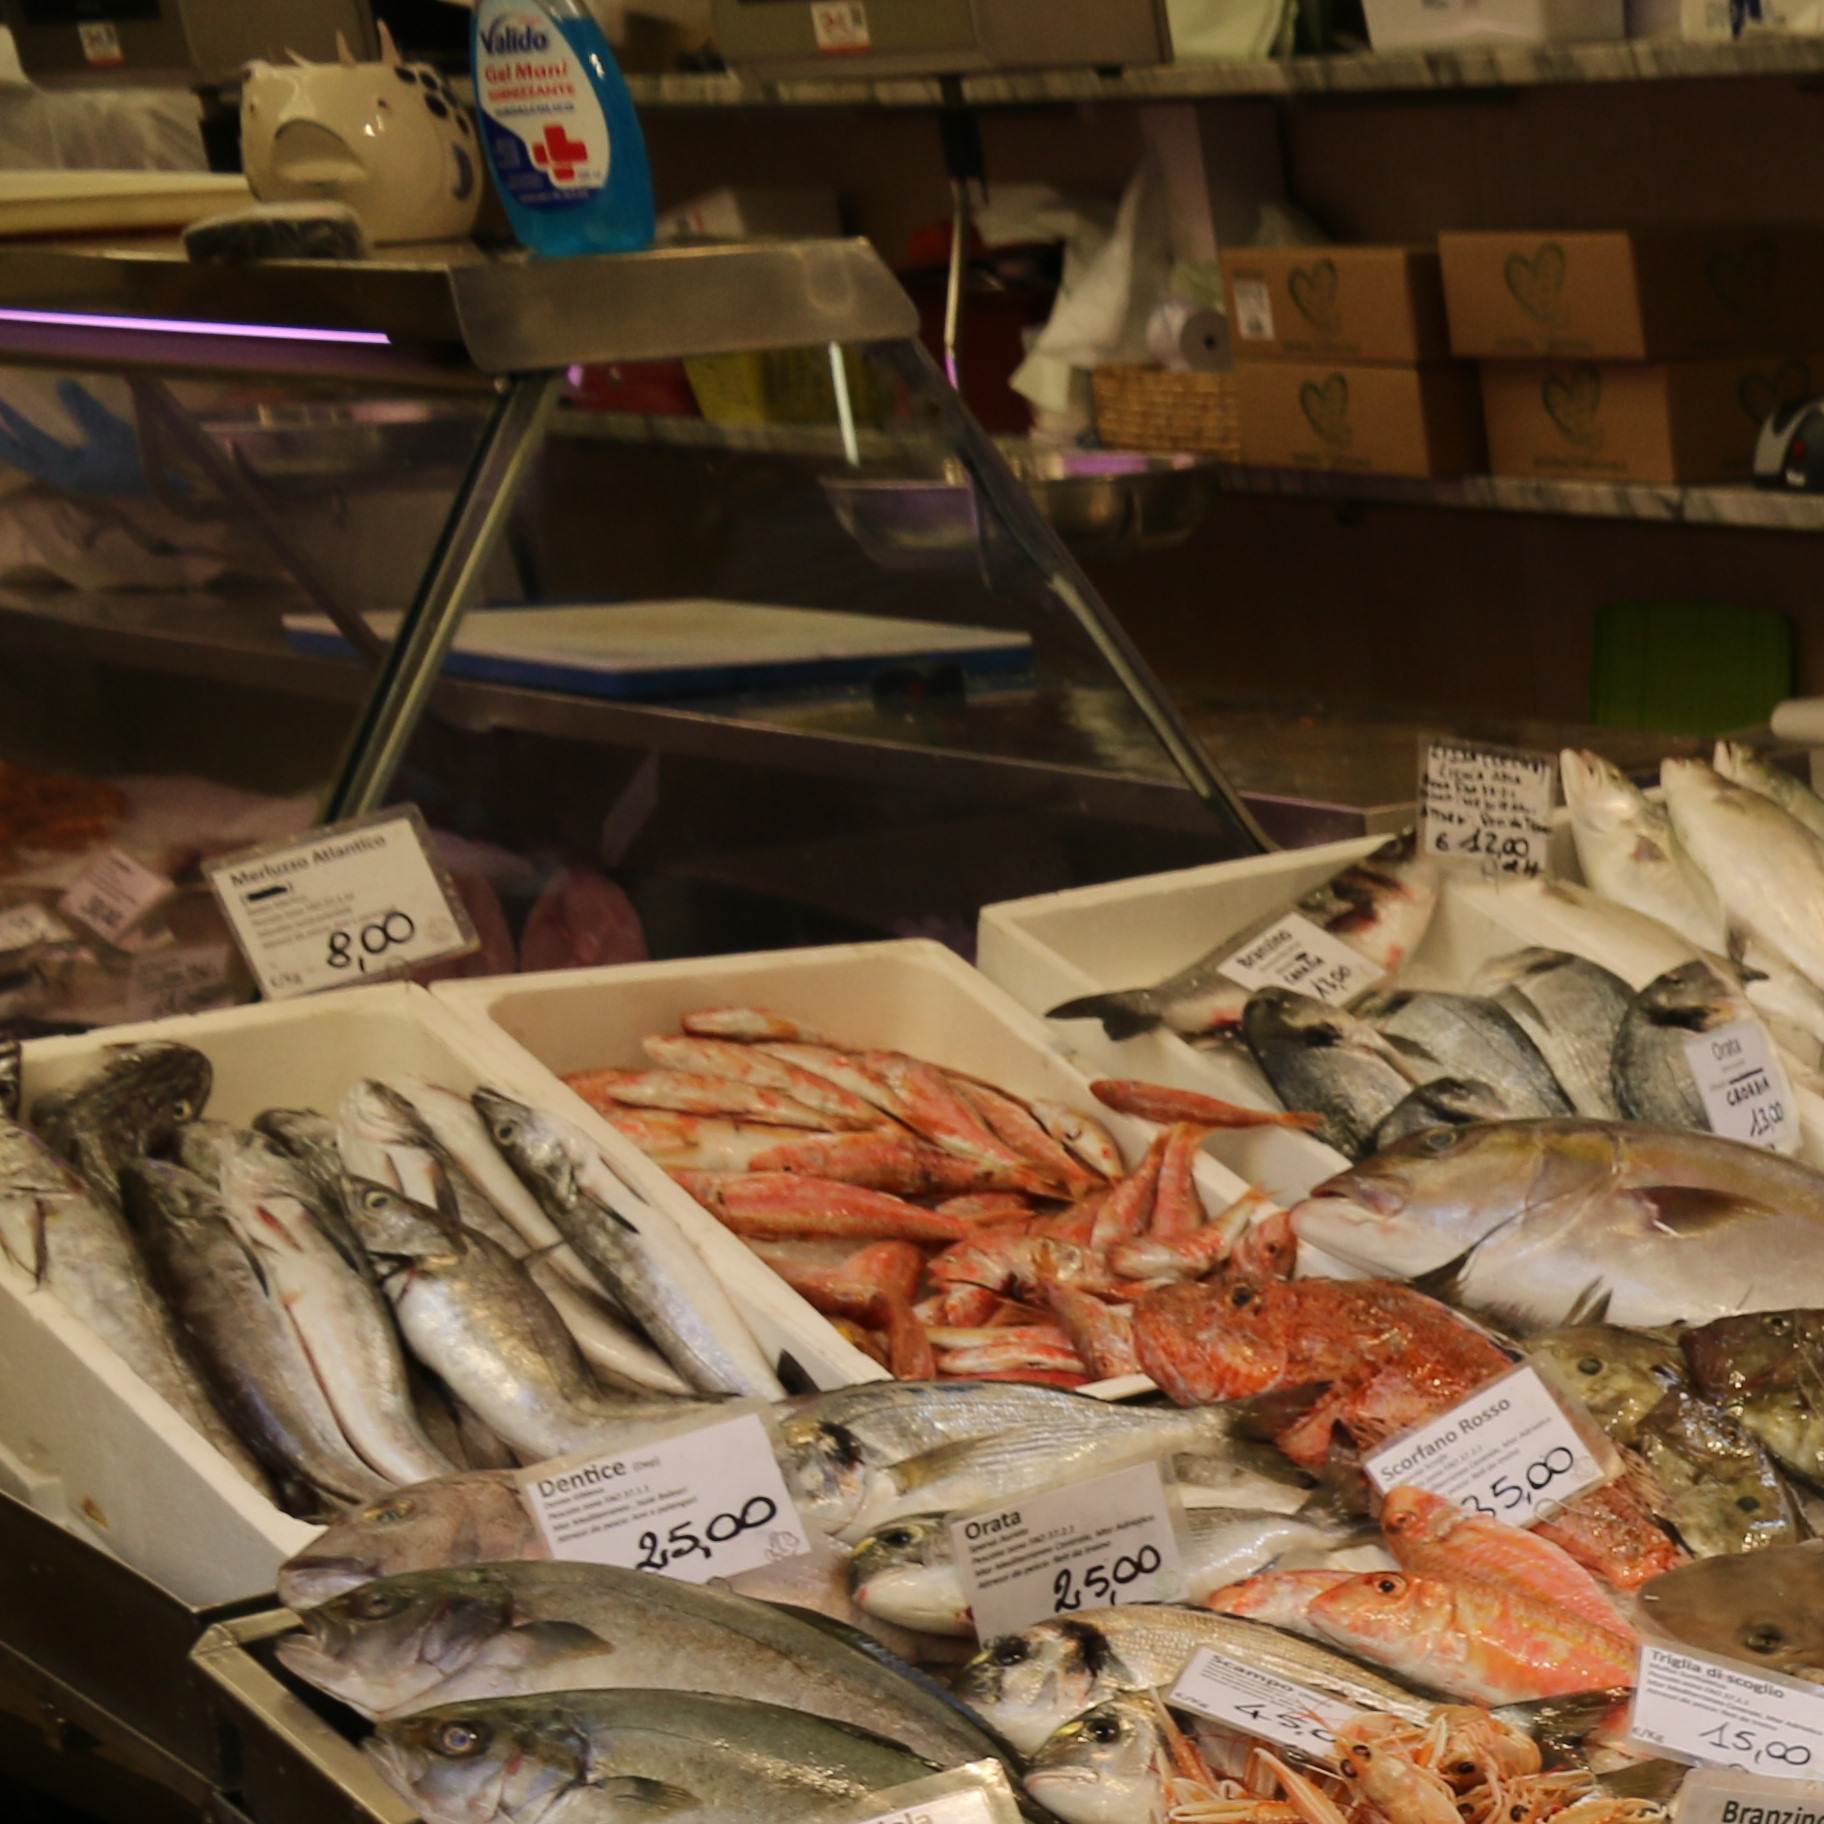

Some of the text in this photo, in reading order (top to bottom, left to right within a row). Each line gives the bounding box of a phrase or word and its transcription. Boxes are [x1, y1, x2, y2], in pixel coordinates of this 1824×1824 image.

[480, 17, 548, 53] Valido
[485, 58, 568, 84] Gel Mani
[312, 835, 387, 866] Atlantico
[1459, 828, 1529, 859] 12,00
[327, 911, 415, 973] 8,00
[1381, 1431, 1458, 1482] Scorfano
[1458, 1398, 1511, 1434] Rosso
[537, 1460, 627, 1499] Dentice
[636, 1496, 777, 1570] 25,00
[965, 1511, 1022, 1540] Orata
[1054, 1545, 1161, 1612] 25,00
[1212, 1655, 1294, 1692] Scampo
[1651, 1650, 1785, 1699] Triglia di scoglio
[1699, 1722, 1811, 1765] 15,00
